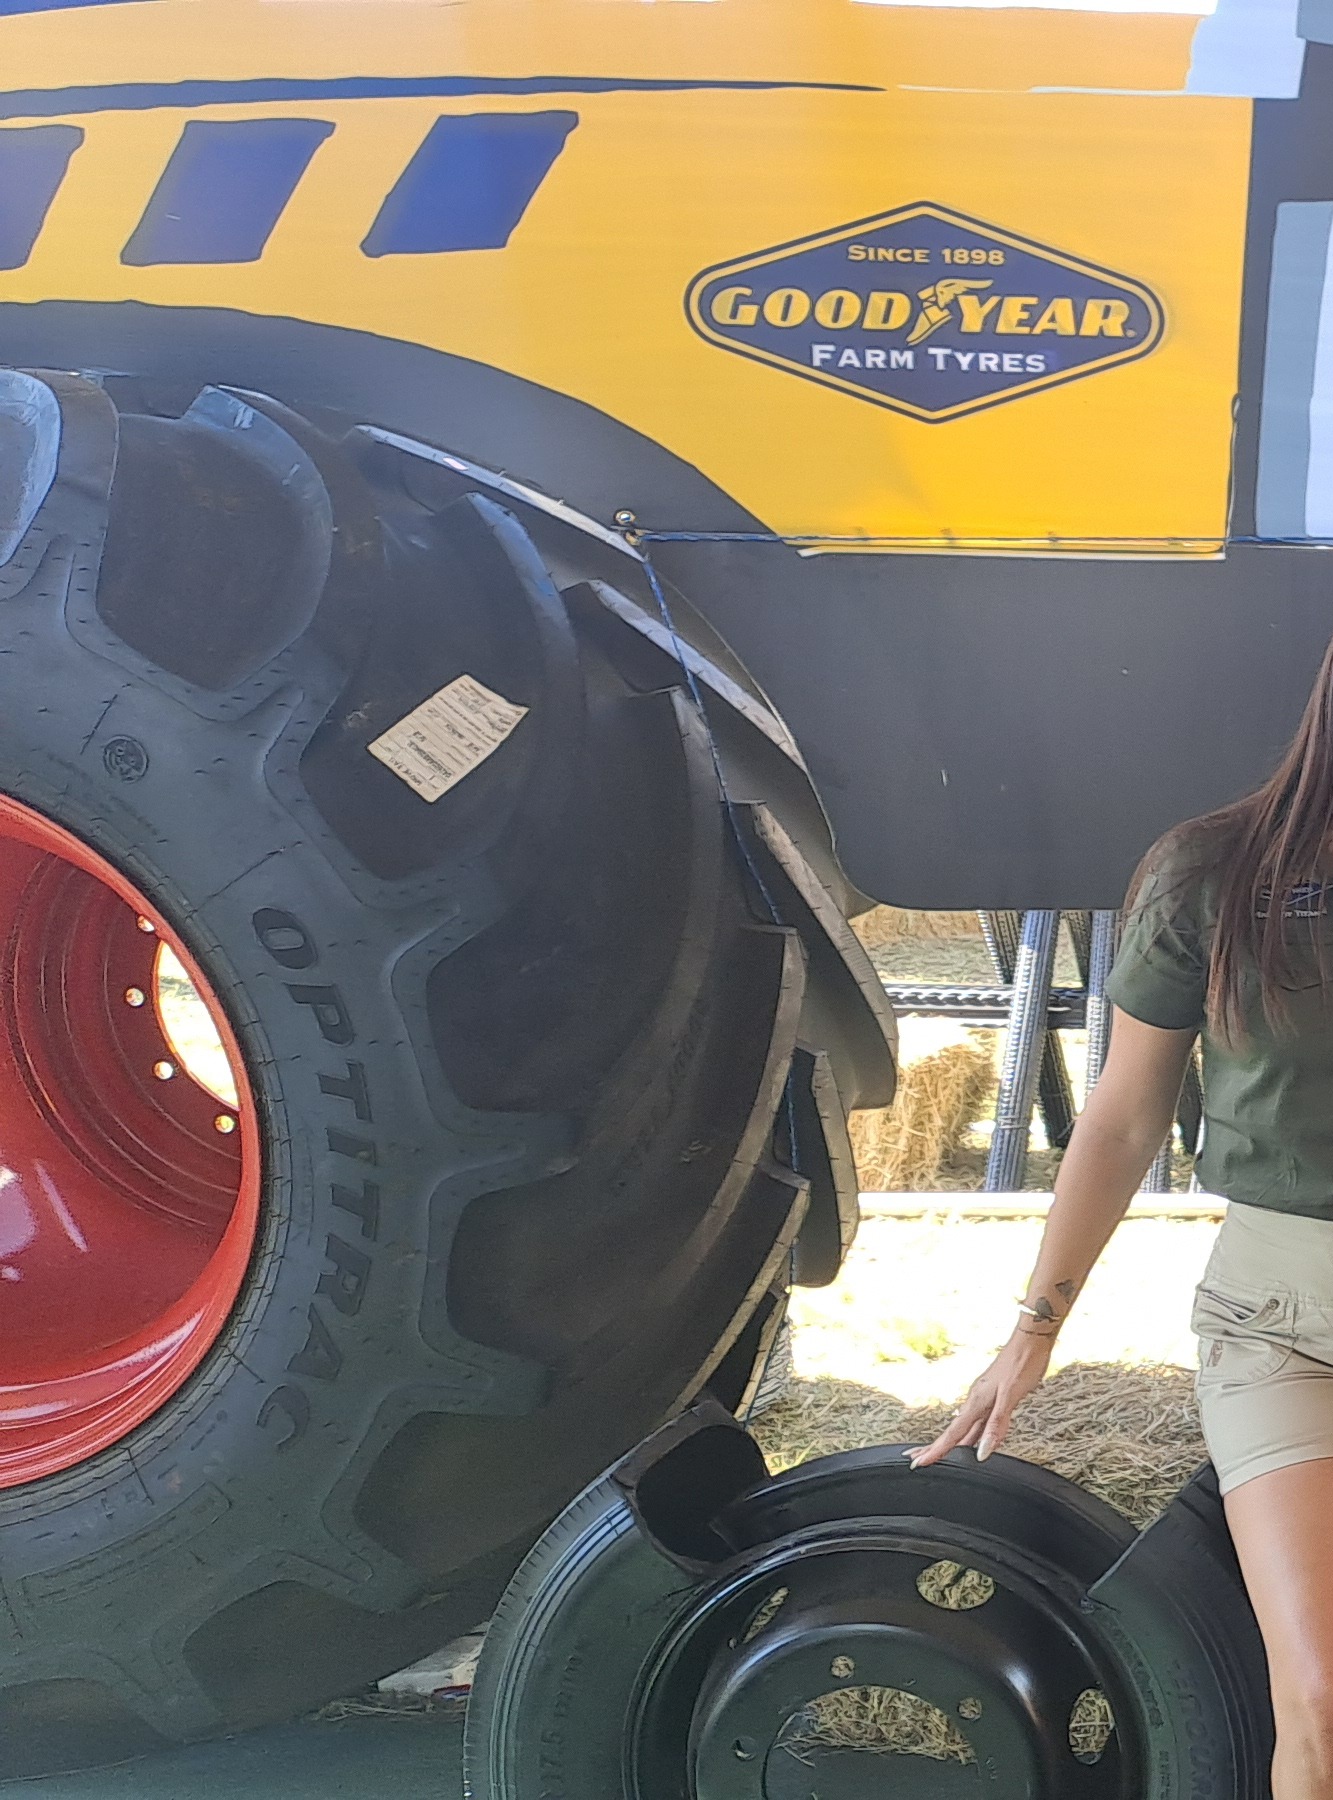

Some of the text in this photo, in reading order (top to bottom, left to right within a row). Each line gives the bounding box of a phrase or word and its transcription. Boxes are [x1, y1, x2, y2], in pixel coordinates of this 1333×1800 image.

[847, 243, 1006, 267] SINCE 1898
[811, 343, 1046, 373] FARM TYRES
[251, 906, 380, 1451] OPTITRAC
